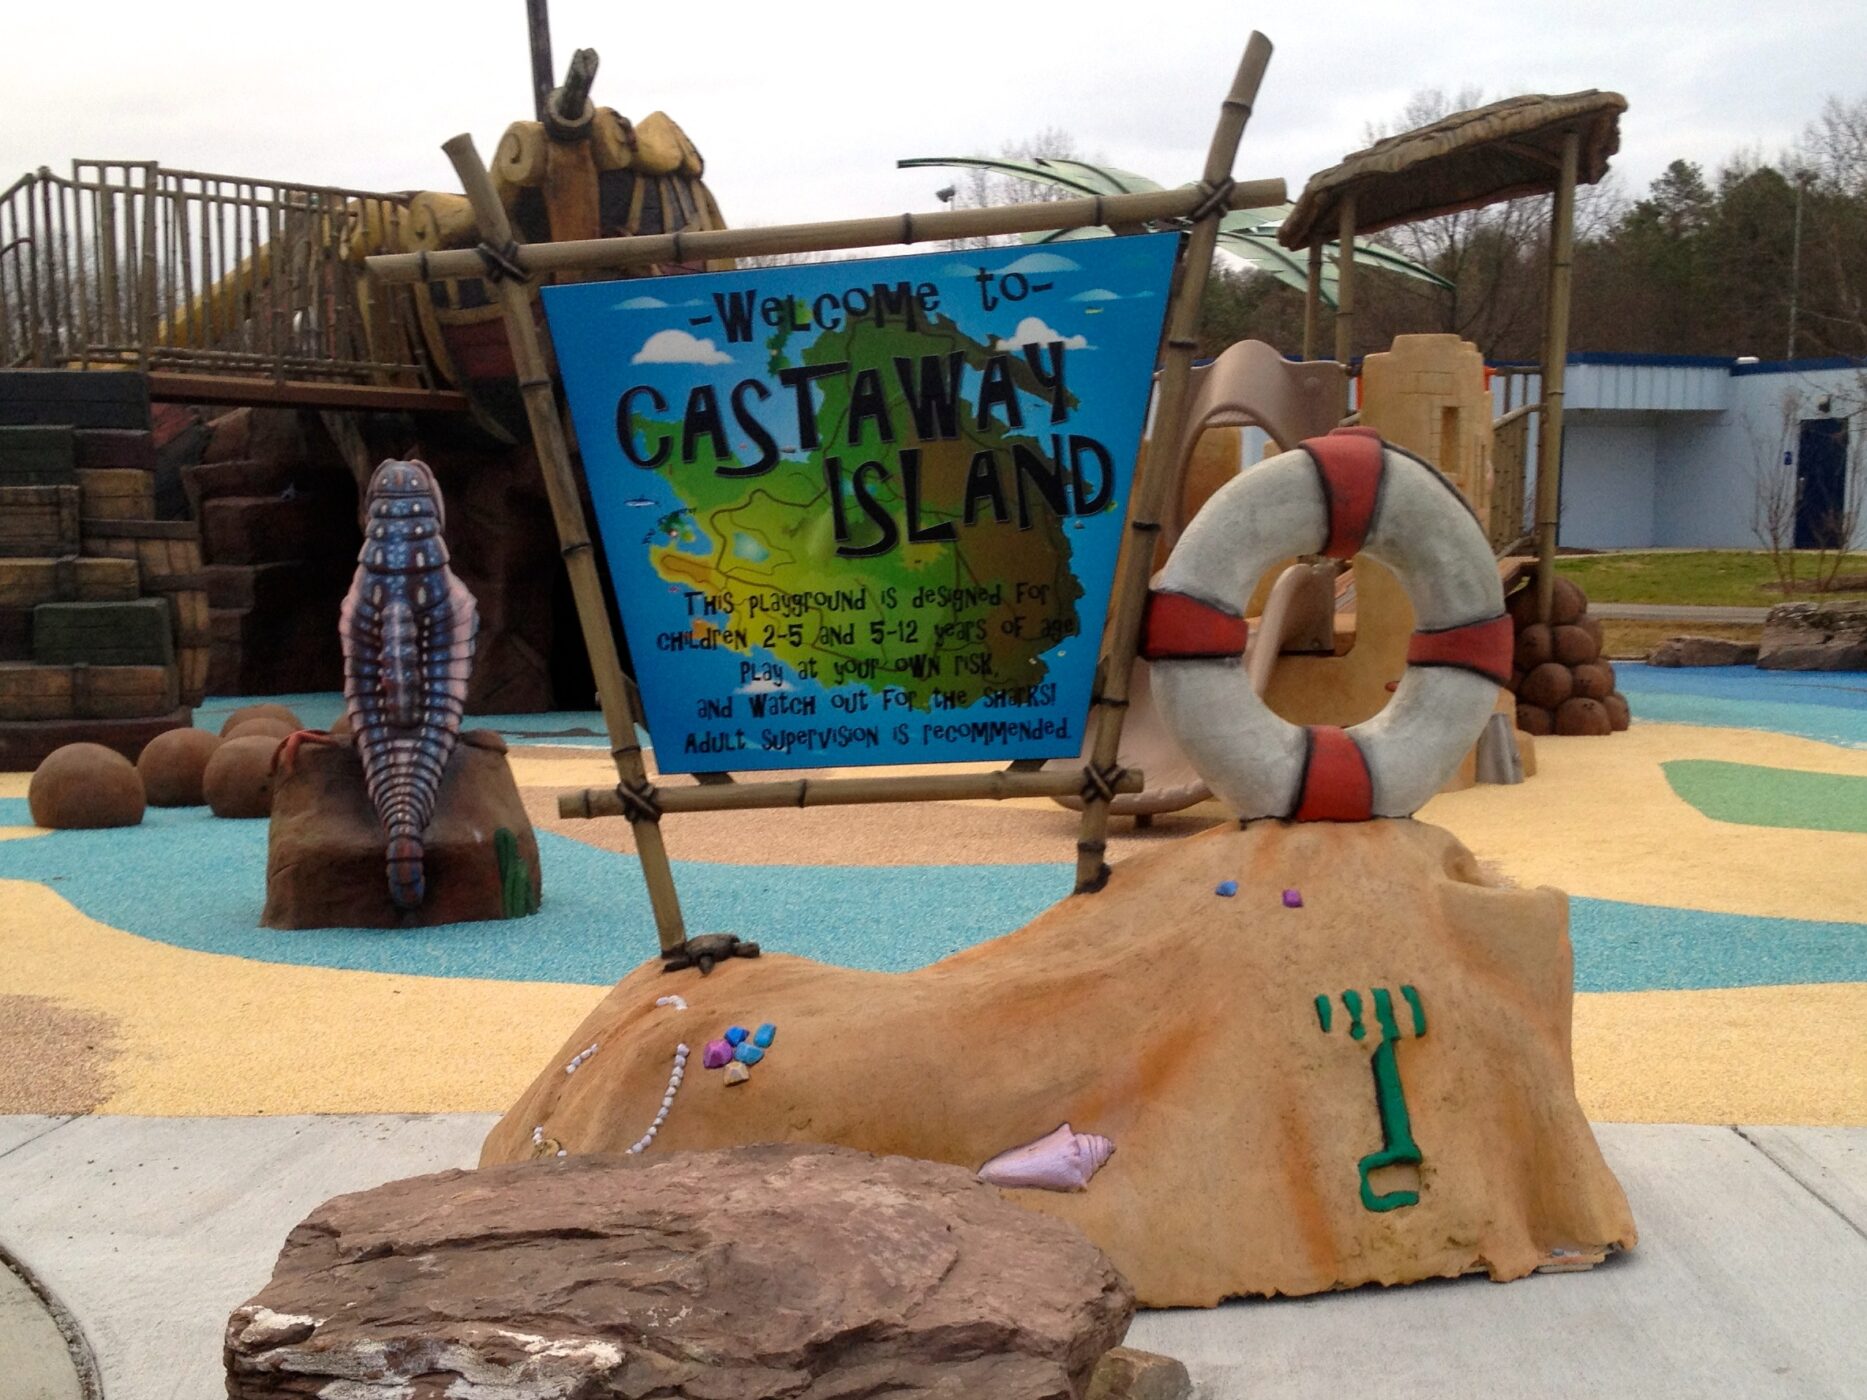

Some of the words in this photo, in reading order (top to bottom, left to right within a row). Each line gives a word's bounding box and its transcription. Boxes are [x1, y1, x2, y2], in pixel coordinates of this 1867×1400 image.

[976, 266, 1054, 311] to-
[616, 340, 1068, 479] CASTAWAY
[824, 433, 1114, 559] ISLAND
[763, 624, 804, 649] 2-5
[870, 619, 919, 644] 5-12
[798, 657, 818, 681] at
